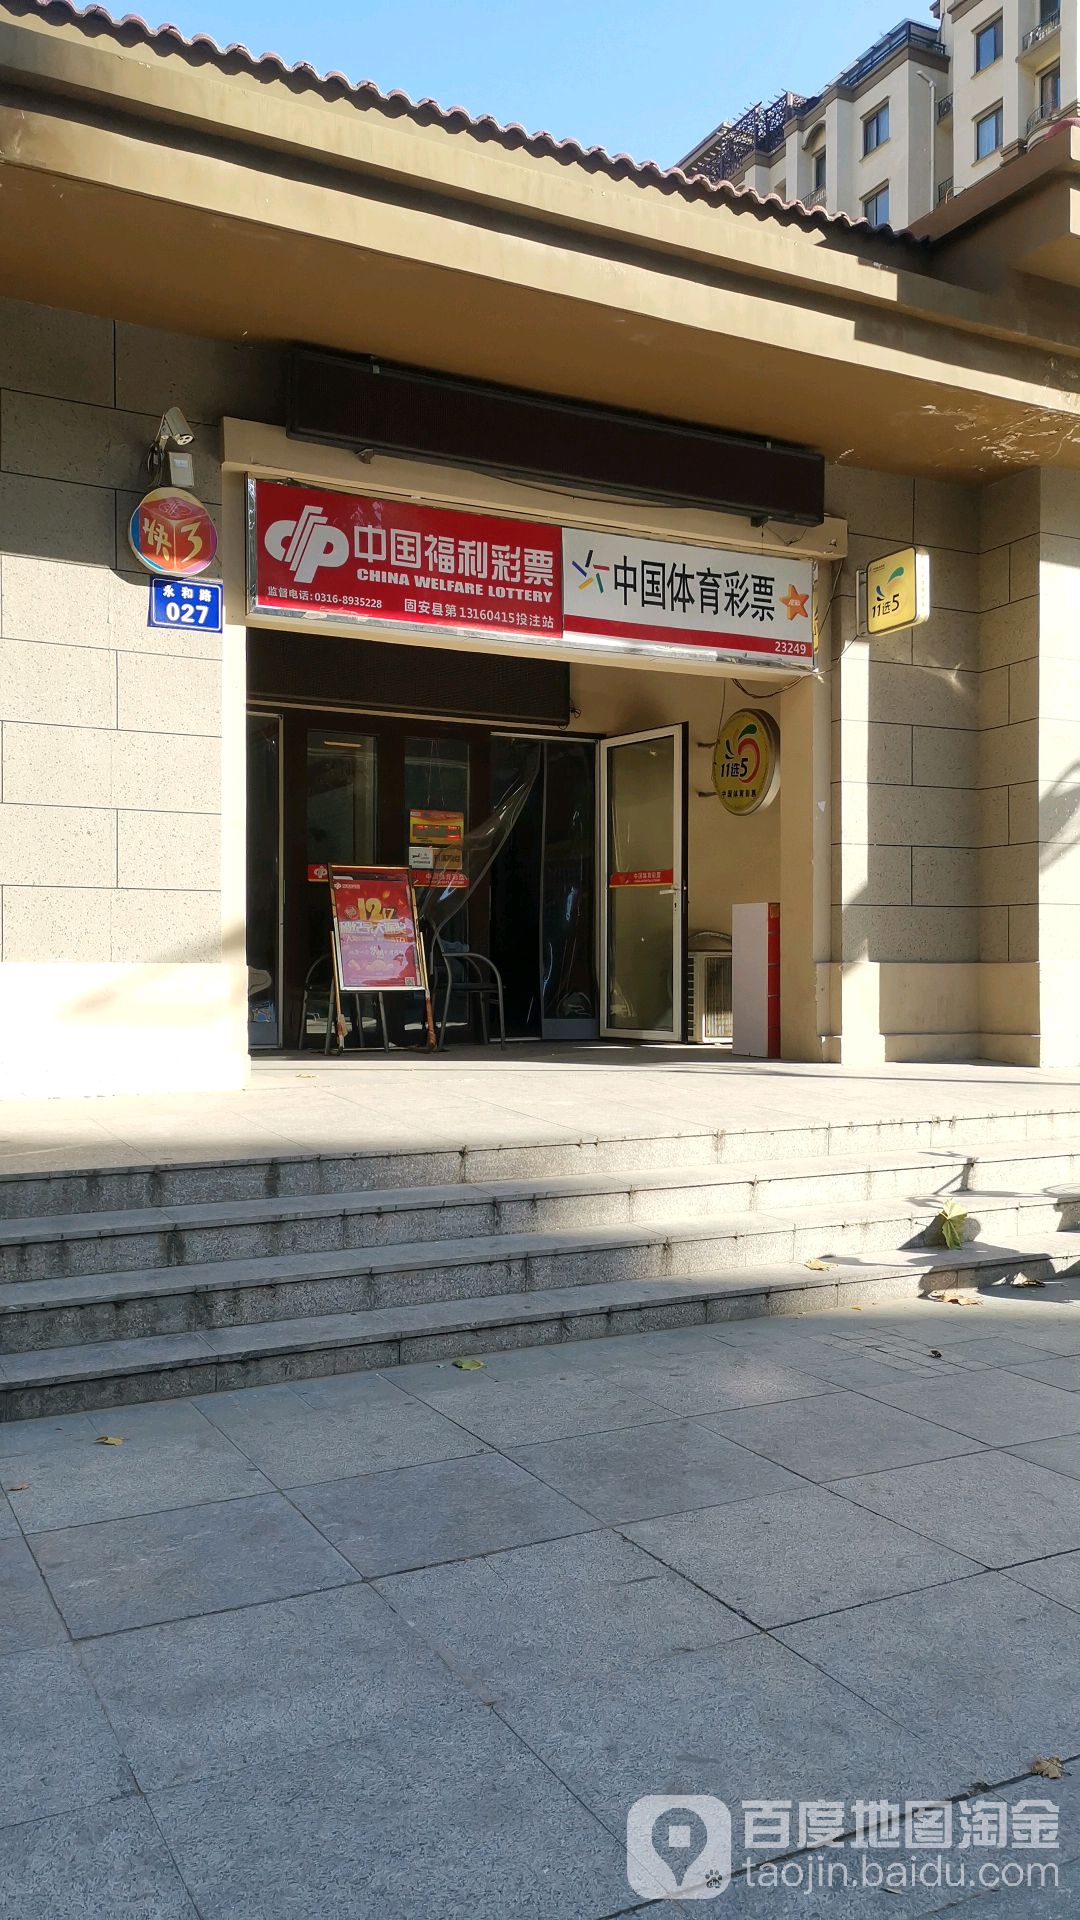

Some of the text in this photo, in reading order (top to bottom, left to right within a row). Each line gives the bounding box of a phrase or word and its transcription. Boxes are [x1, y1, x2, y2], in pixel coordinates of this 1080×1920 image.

[354, 524, 554, 587] 中国福利彩票
[163, 584, 212, 602] 永和路
[357, 568, 553, 603] CHINA WELFARE LOTTERY
[613, 555, 775, 622] 中国体育彩票
[166, 602, 209, 624] 027
[774, 641, 807, 655] 23249
[720, 757, 749, 778] 11选5
